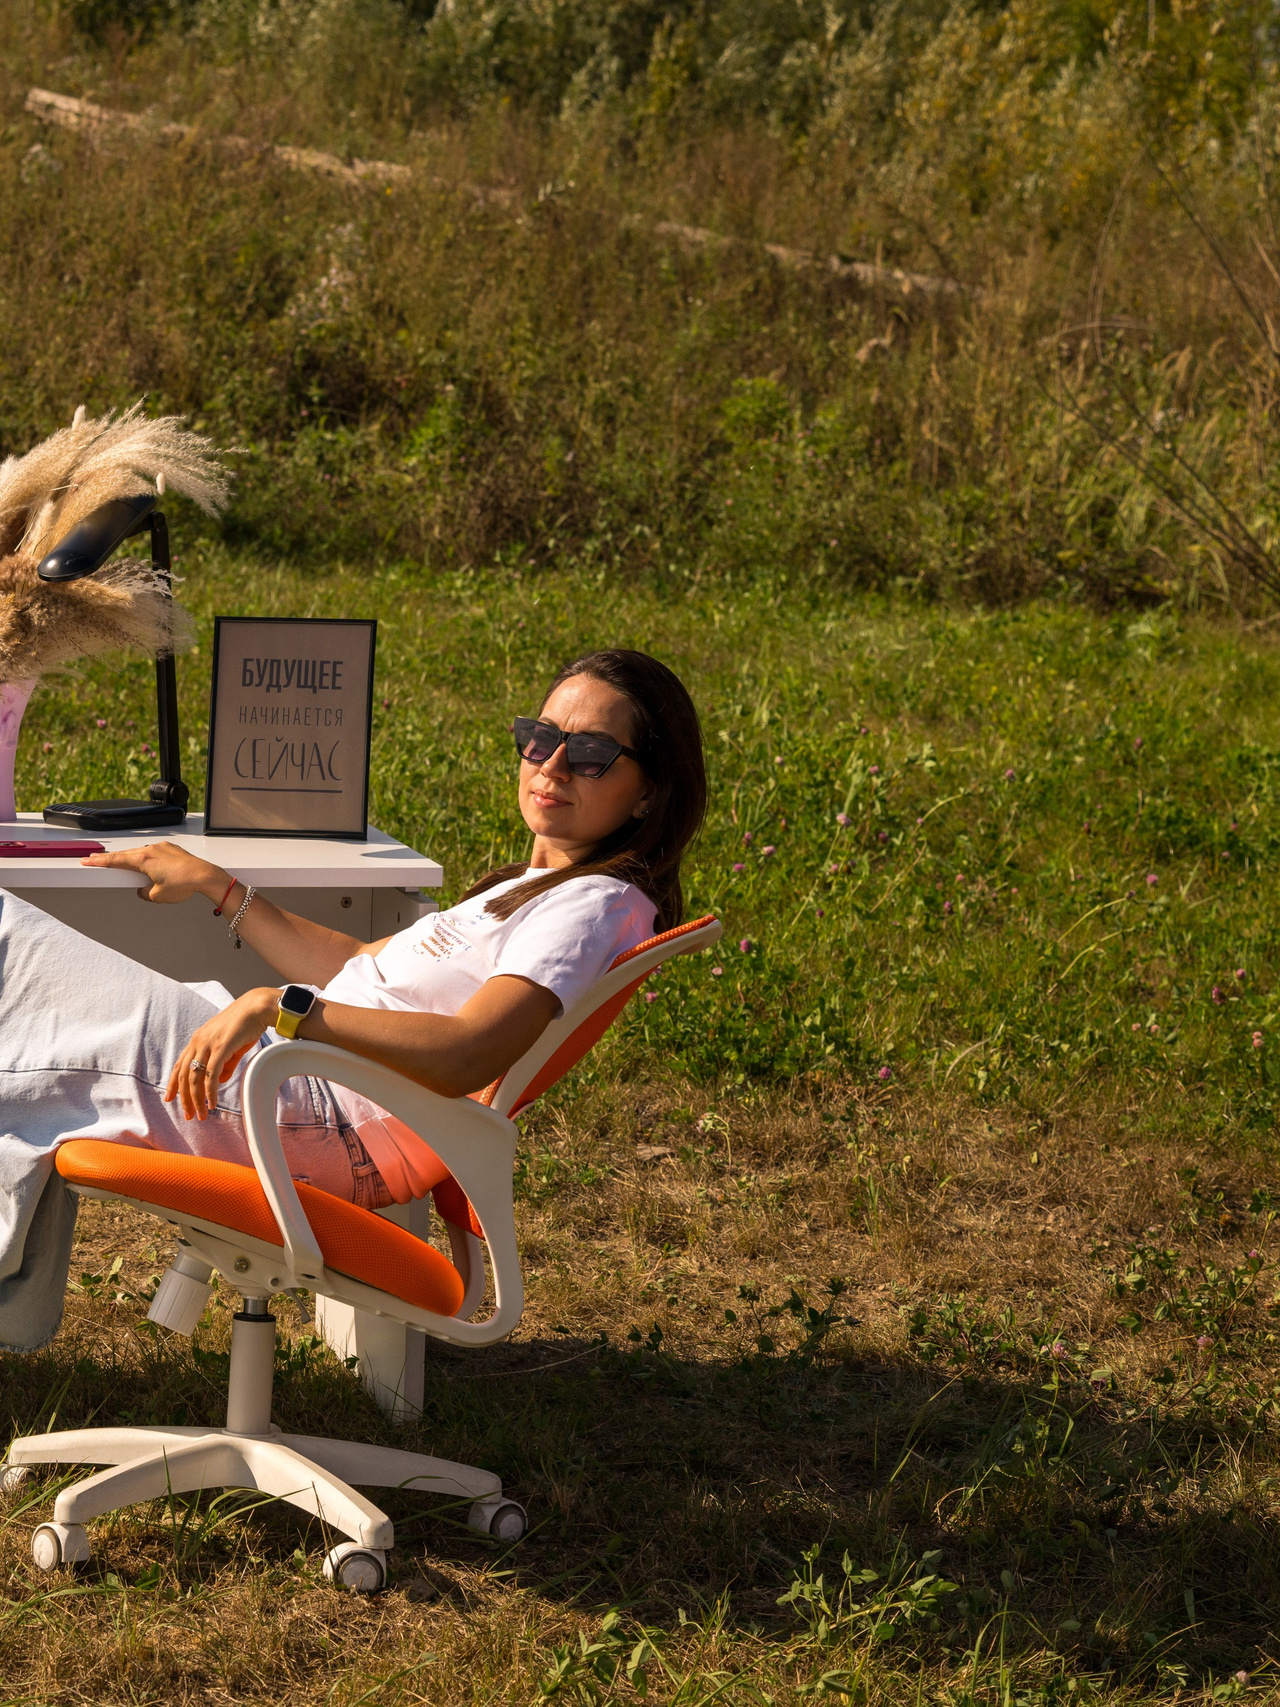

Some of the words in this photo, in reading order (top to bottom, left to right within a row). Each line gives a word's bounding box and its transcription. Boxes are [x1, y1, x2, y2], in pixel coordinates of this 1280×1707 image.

[241, 657, 344, 694] БУДУЩЕЕ
[239, 706, 343, 727] НАЧИНАЕТСЯ
[234, 736, 343, 781] СЕЙЧАС
